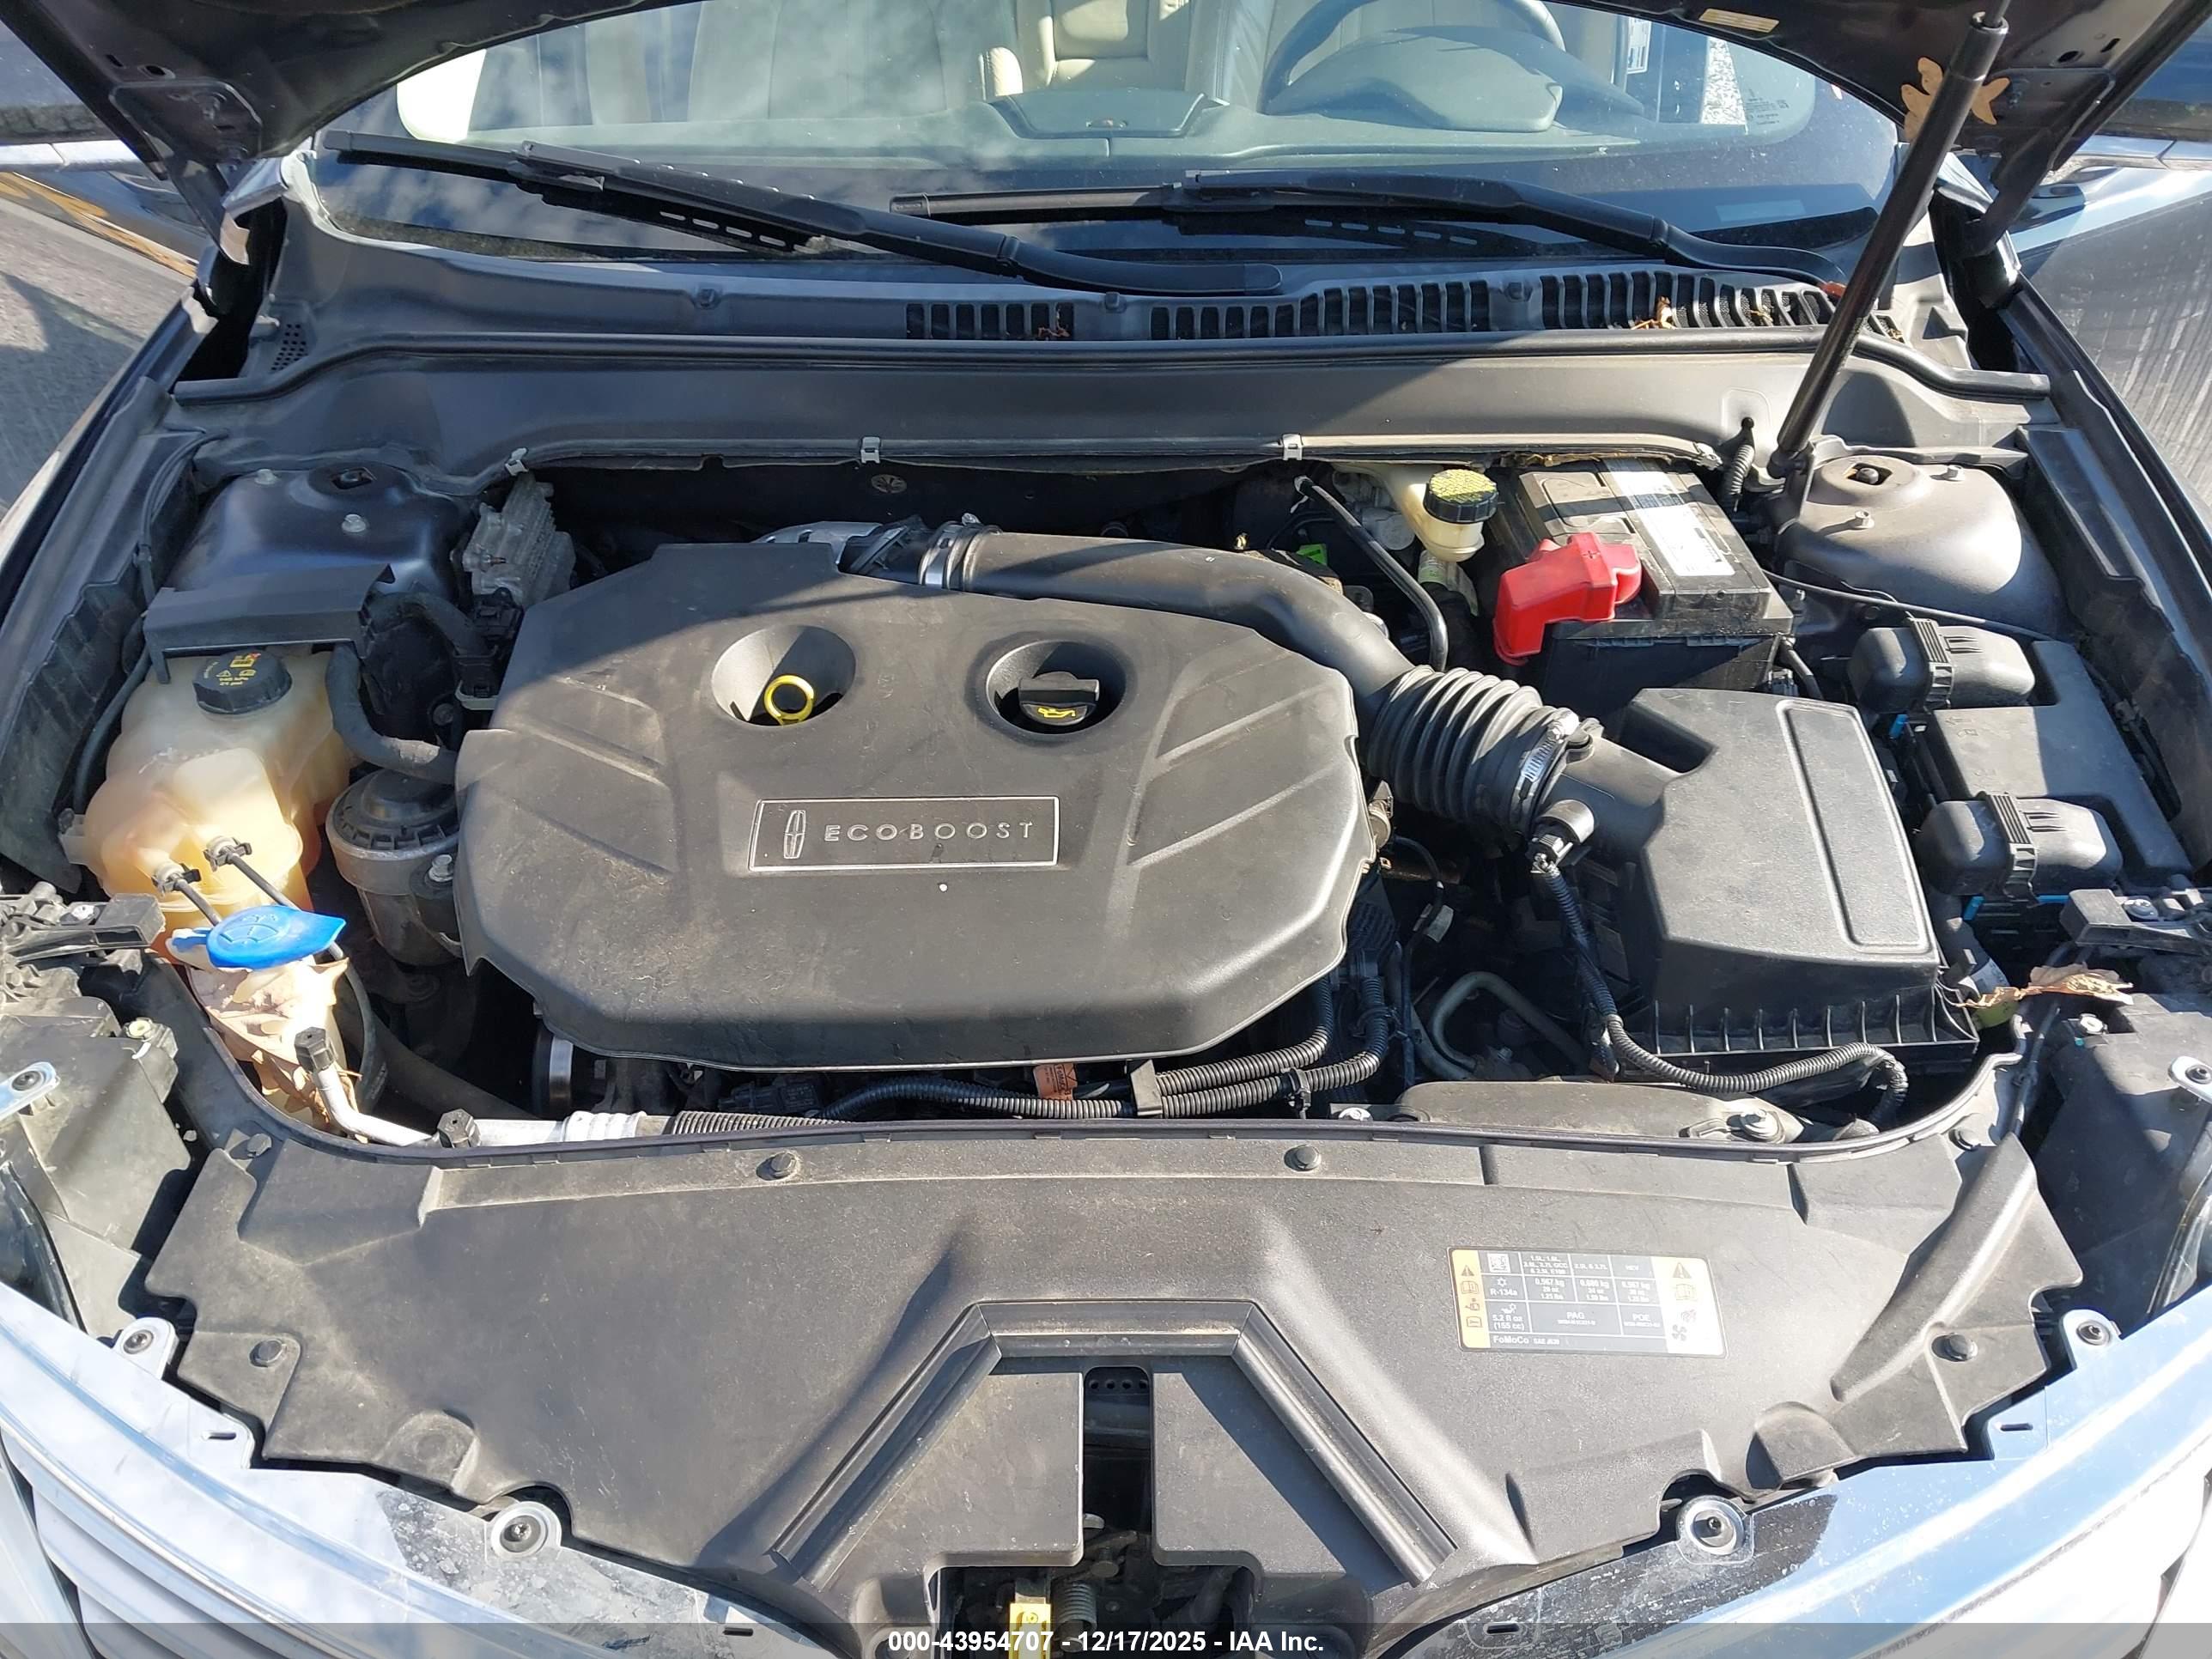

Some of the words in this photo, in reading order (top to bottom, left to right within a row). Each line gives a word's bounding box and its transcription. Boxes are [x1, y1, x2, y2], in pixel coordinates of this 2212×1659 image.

[824, 820, 1034, 842] ECOBOOST
[1555, 1279, 1565, 1288] kg
[1490, 1287, 1518, 1296] R-134a
[1492, 1335, 1529, 1345] FoMoCo
